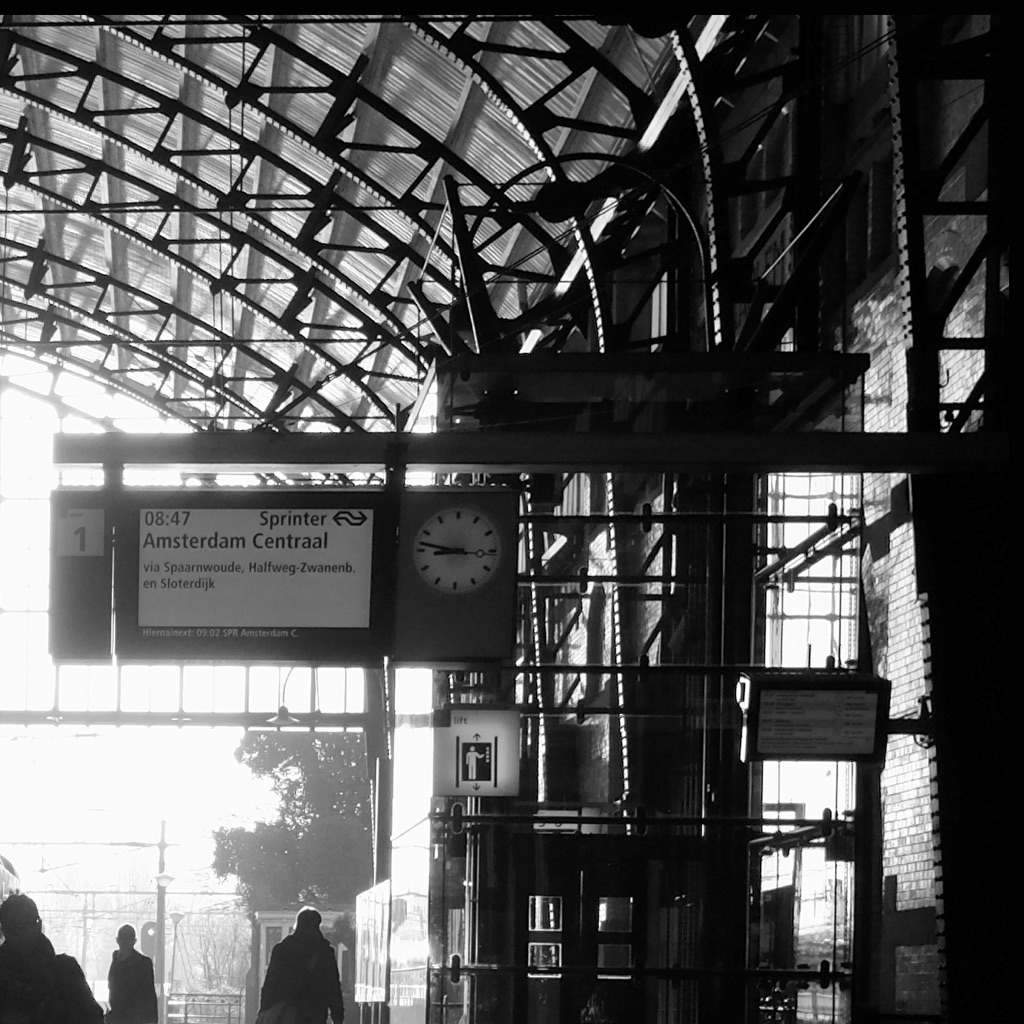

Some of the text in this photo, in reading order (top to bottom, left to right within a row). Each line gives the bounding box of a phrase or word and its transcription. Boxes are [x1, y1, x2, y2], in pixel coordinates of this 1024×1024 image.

[144, 510, 327, 530] 08:47 Sprinter
[74, 526, 86, 552] 1
[143, 532, 328, 549] Amsterdam Centraal
[143, 562, 356, 575] via Spaarnwoude, Halfweg-Zwanenb.
[143, 578, 215, 592] en Sloterdijk
[222, 629, 239, 638] SPR
[241, 629, 289, 638] Amsterdam
[453, 716, 468, 725] lift
